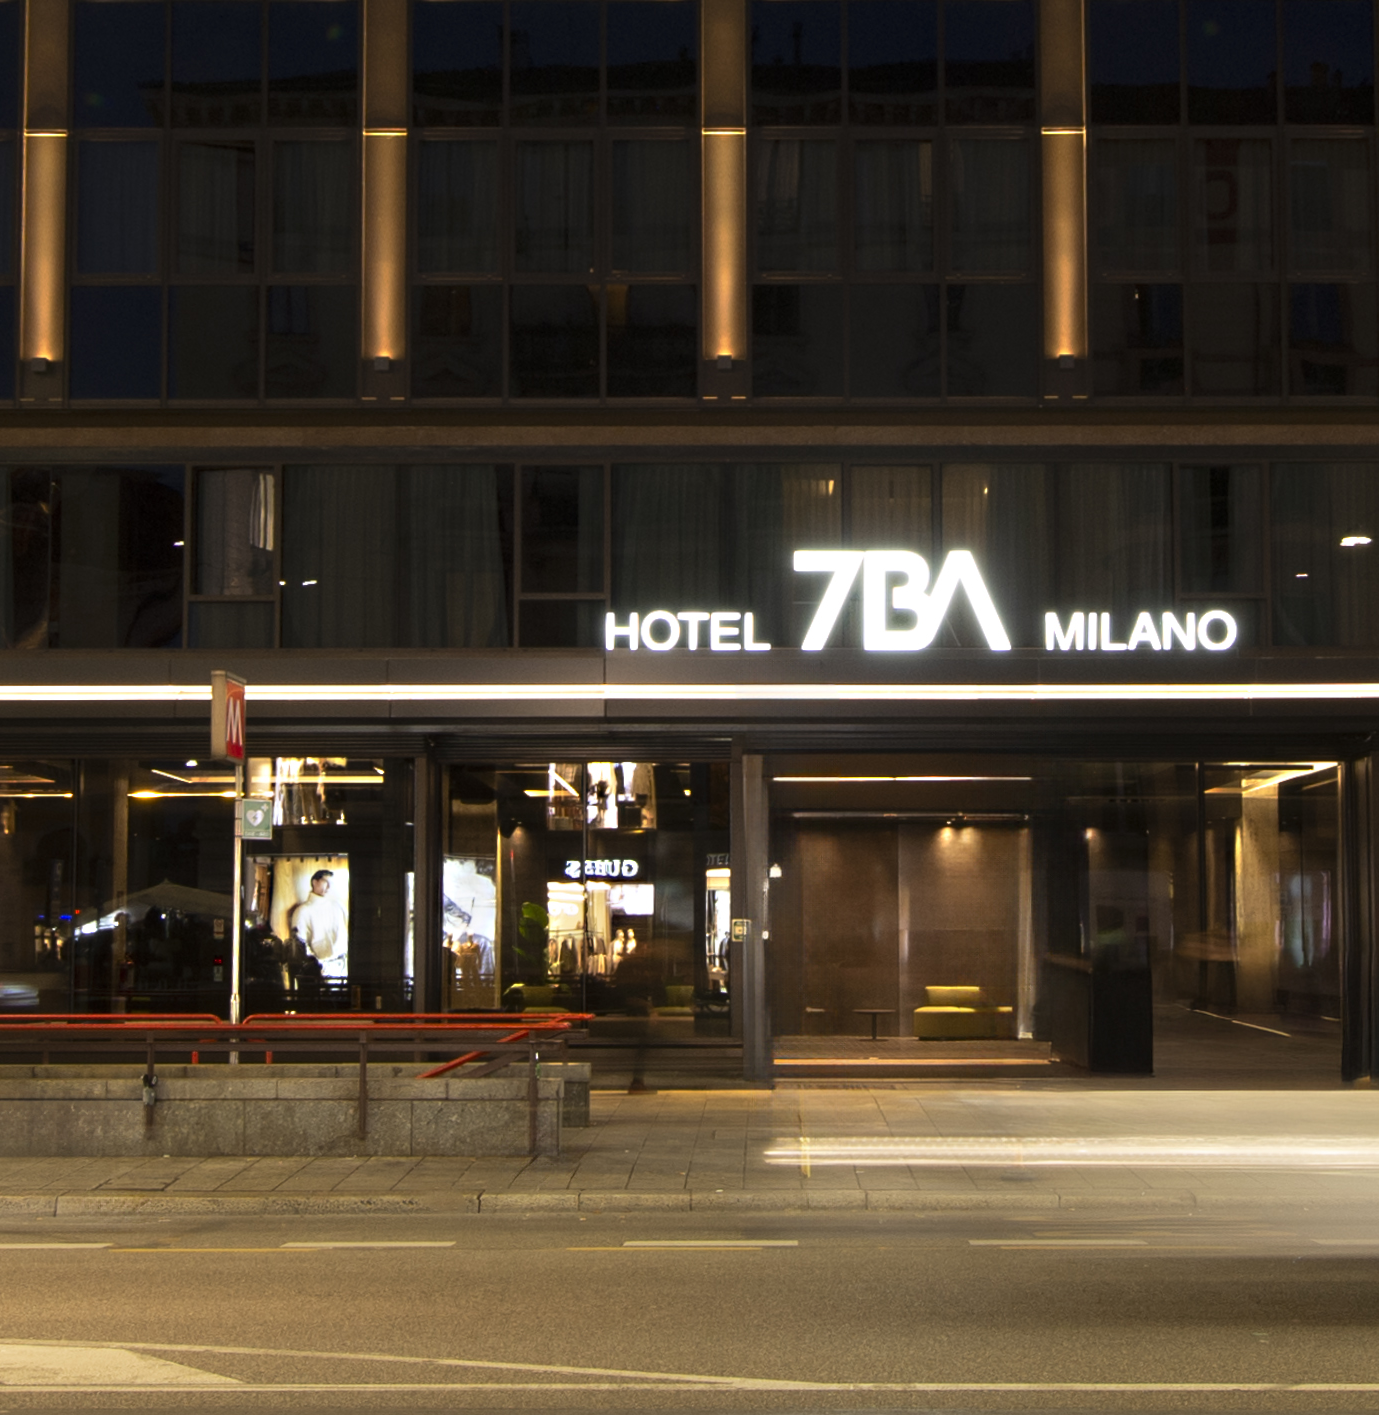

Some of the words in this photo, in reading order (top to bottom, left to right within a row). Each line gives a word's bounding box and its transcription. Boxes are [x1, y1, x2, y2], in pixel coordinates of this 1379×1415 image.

[604, 610, 772, 651] HOTEL
[1044, 610, 1238, 651] MILANO
[226, 696, 243, 746] M
